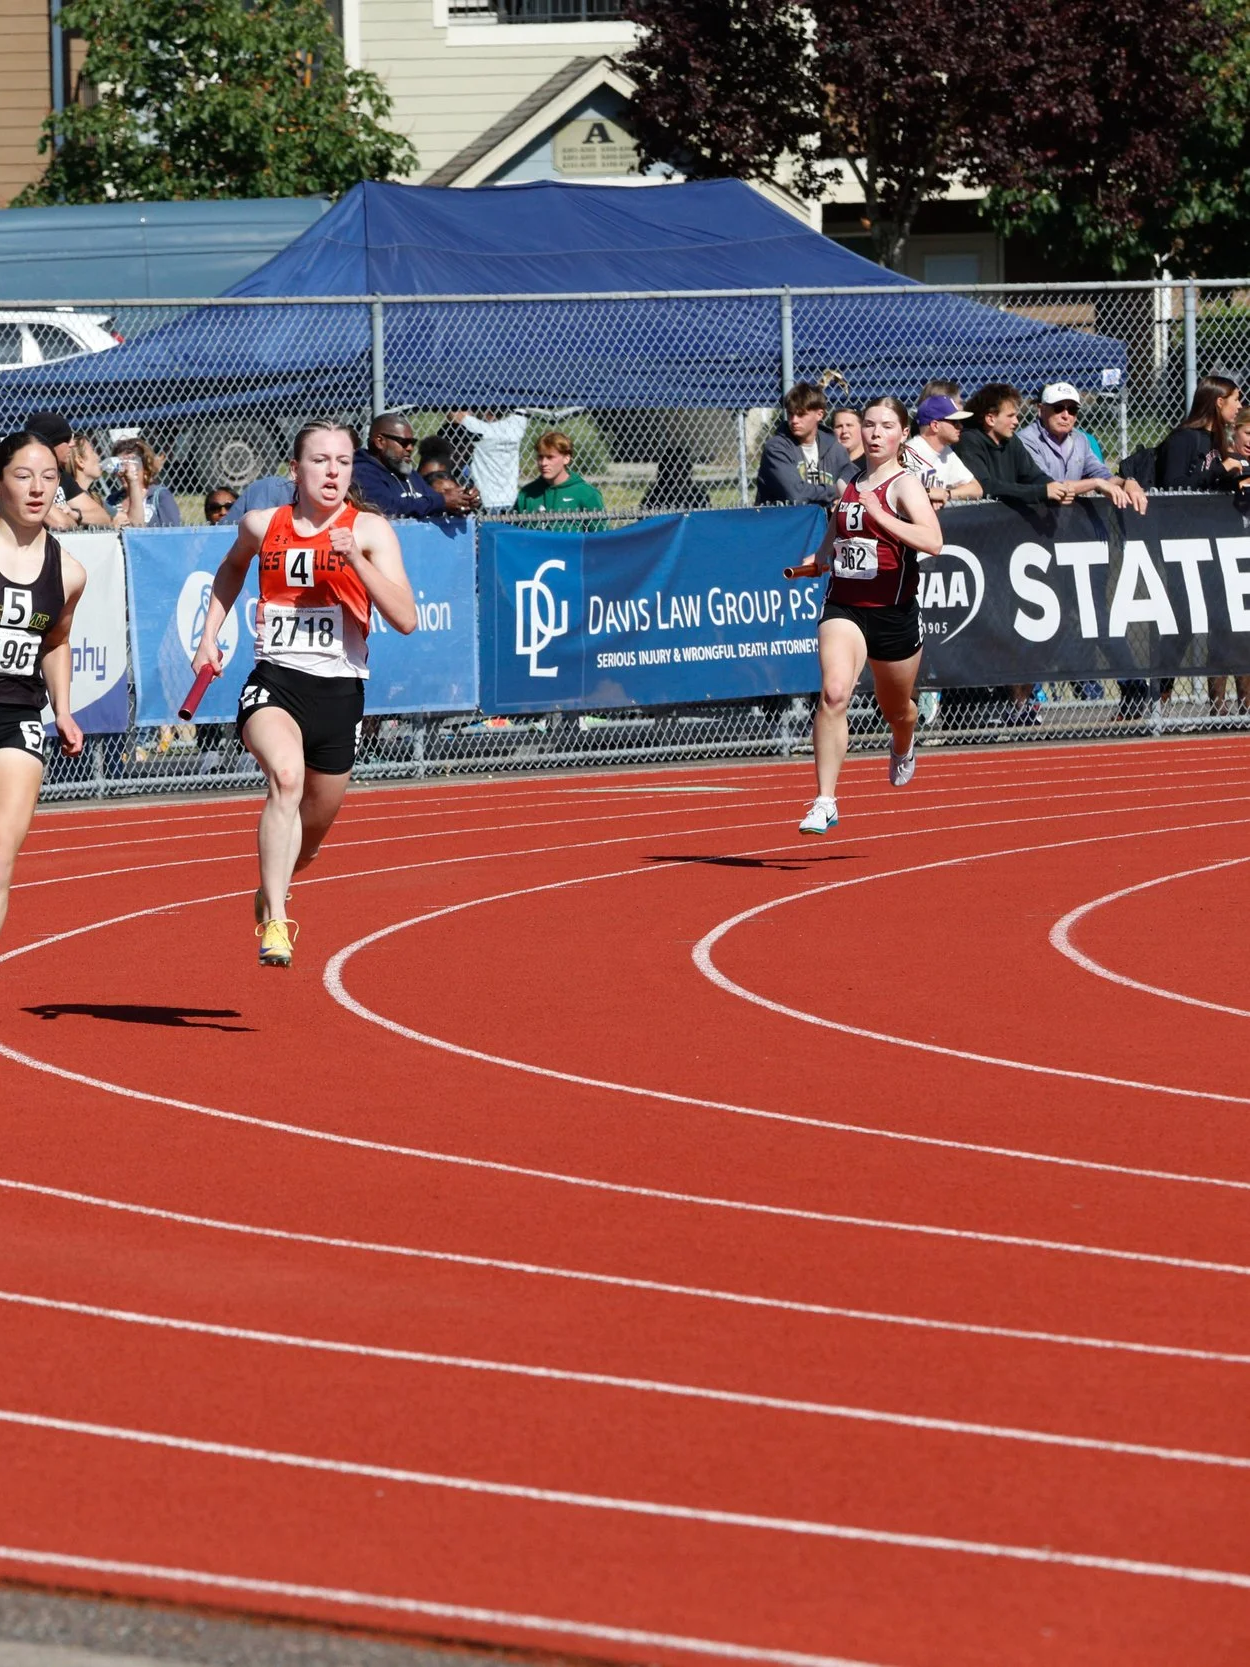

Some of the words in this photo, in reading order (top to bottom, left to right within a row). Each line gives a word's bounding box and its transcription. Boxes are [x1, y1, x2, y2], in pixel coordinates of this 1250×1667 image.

[582, 122, 614, 144] A
[849, 504, 860, 529] 3
[290, 552, 308, 585] 4
[840, 546, 867, 571] 362
[1008, 536, 1250, 642] STATE
[7, 591, 26, 625] 5
[271, 616, 334, 648] 2718
[596, 652, 636, 668] SERIOUS
[639, 649, 671, 666] INJURY
[673, 648, 682, 662] &
[682, 645, 737, 661] WRONGFUL
[739, 642, 768, 657] DEATH
